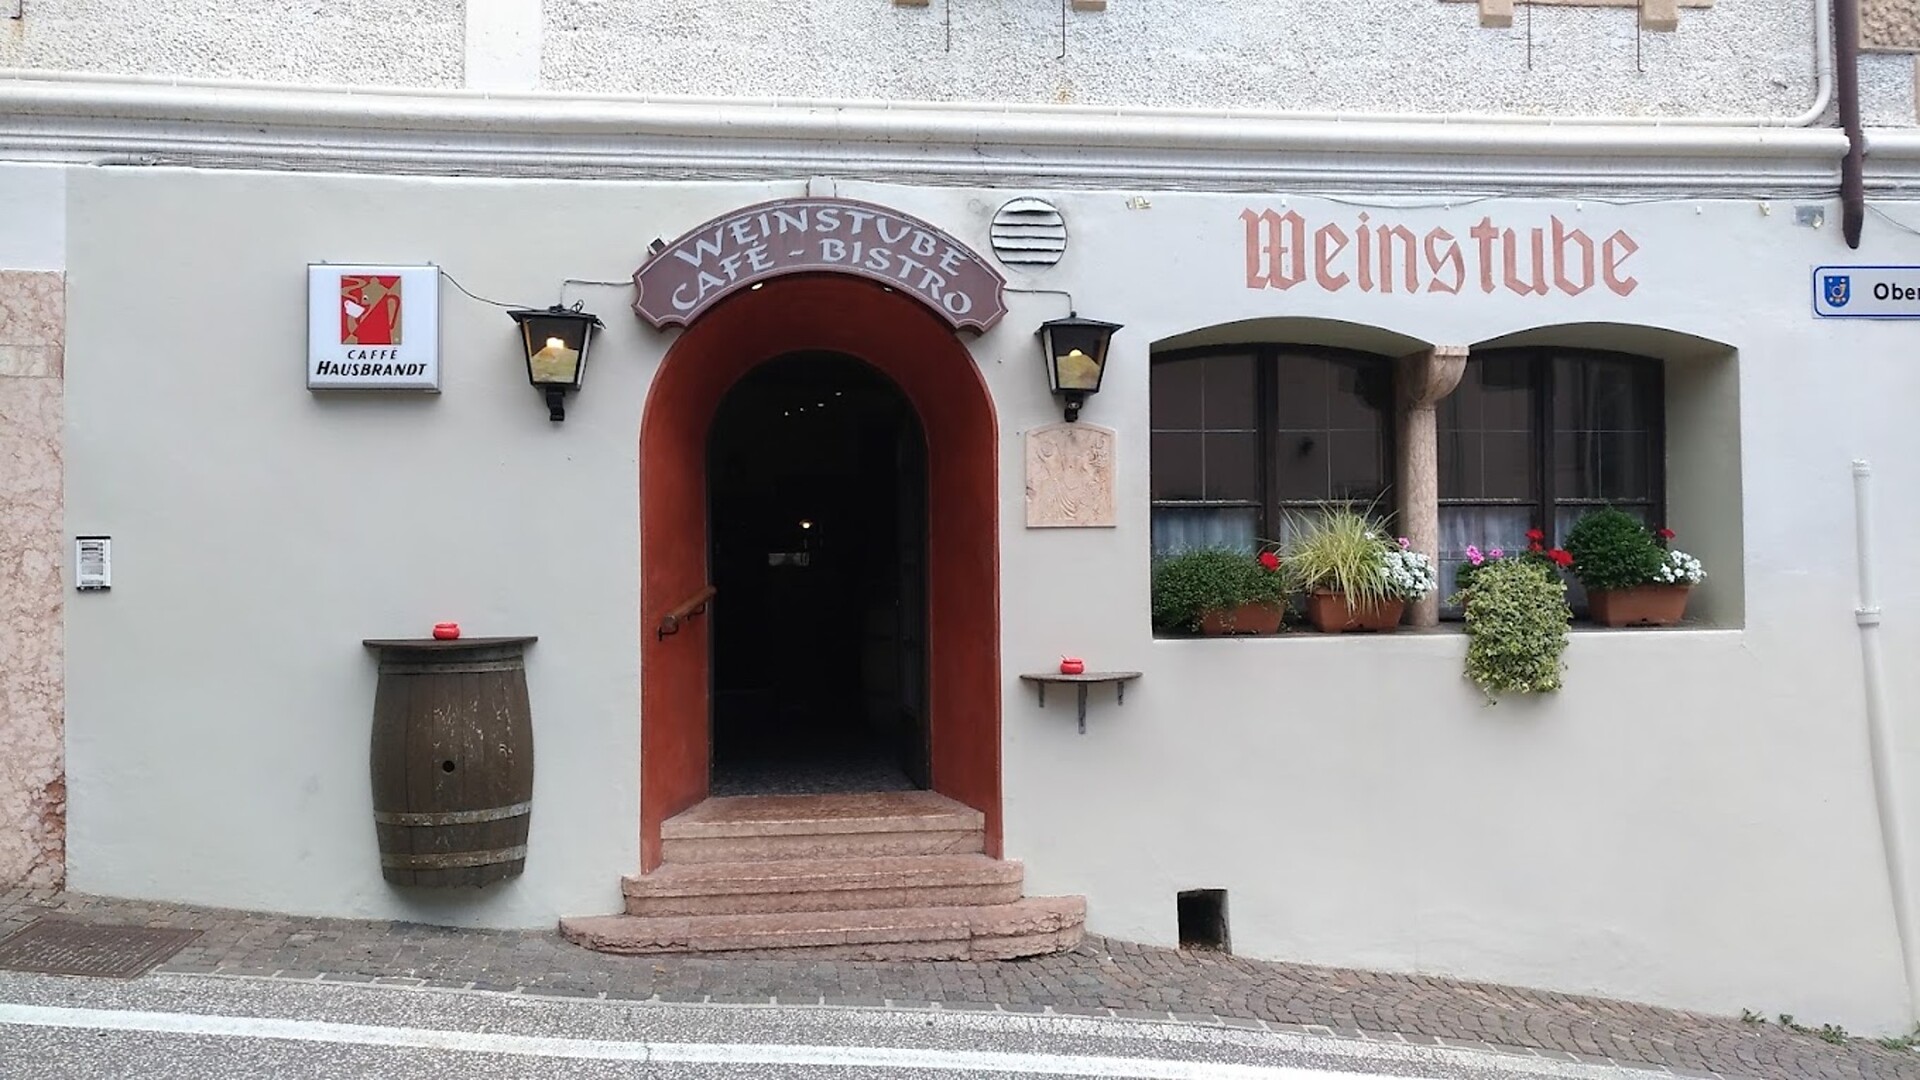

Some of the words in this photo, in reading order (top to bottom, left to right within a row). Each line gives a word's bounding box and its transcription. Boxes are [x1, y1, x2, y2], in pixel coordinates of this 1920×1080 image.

[818, 238, 972, 315] BISTRO
[1238, 207, 1640, 298] Weinstube
[1873, 282, 1920, 301] Obe
[316, 360, 428, 377] HAUSBRANDT
